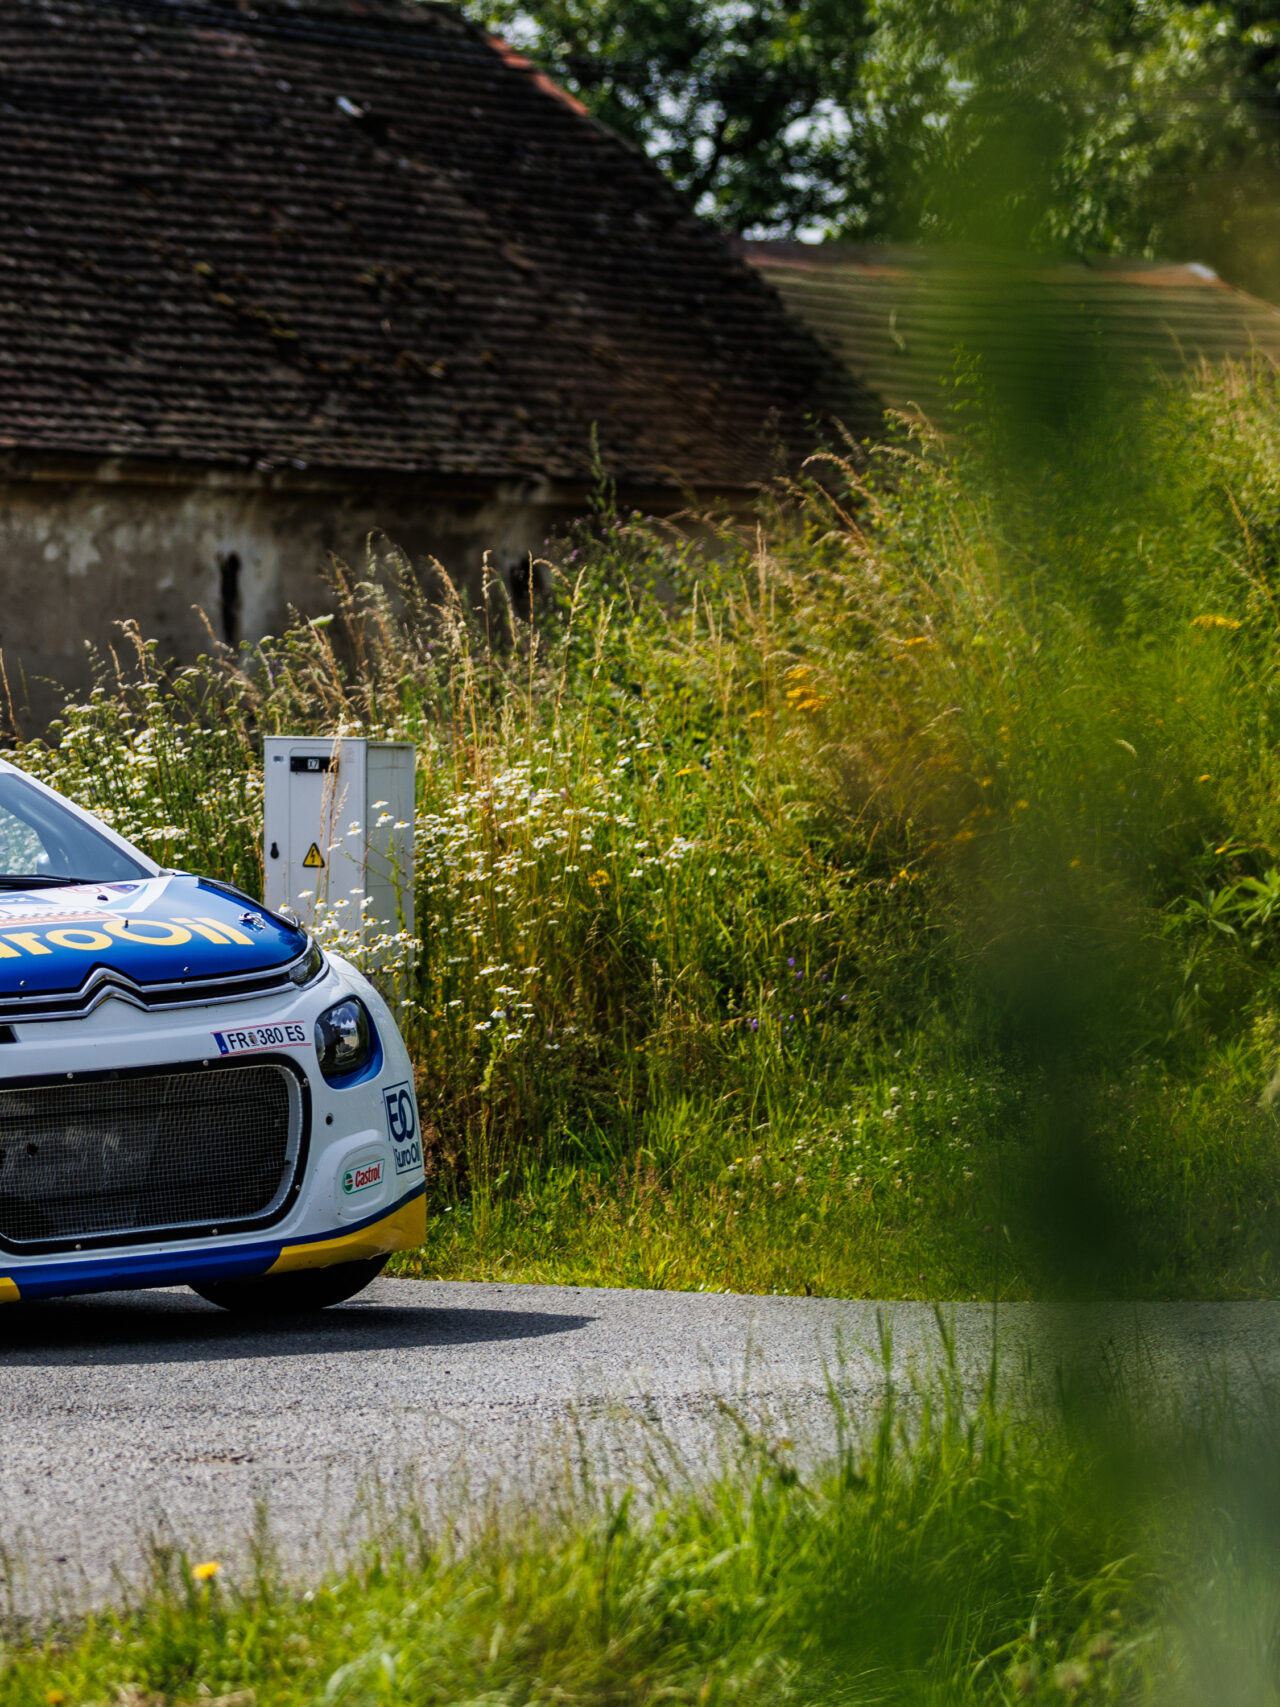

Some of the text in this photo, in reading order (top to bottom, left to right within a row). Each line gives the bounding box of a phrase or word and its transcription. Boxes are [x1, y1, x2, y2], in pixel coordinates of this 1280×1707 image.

[227, 1032, 250, 1050] FR
[256, 1027, 284, 1045] 380
[284, 1025, 306, 1042] ES
[355, 1163, 381, 1188] Castrol
